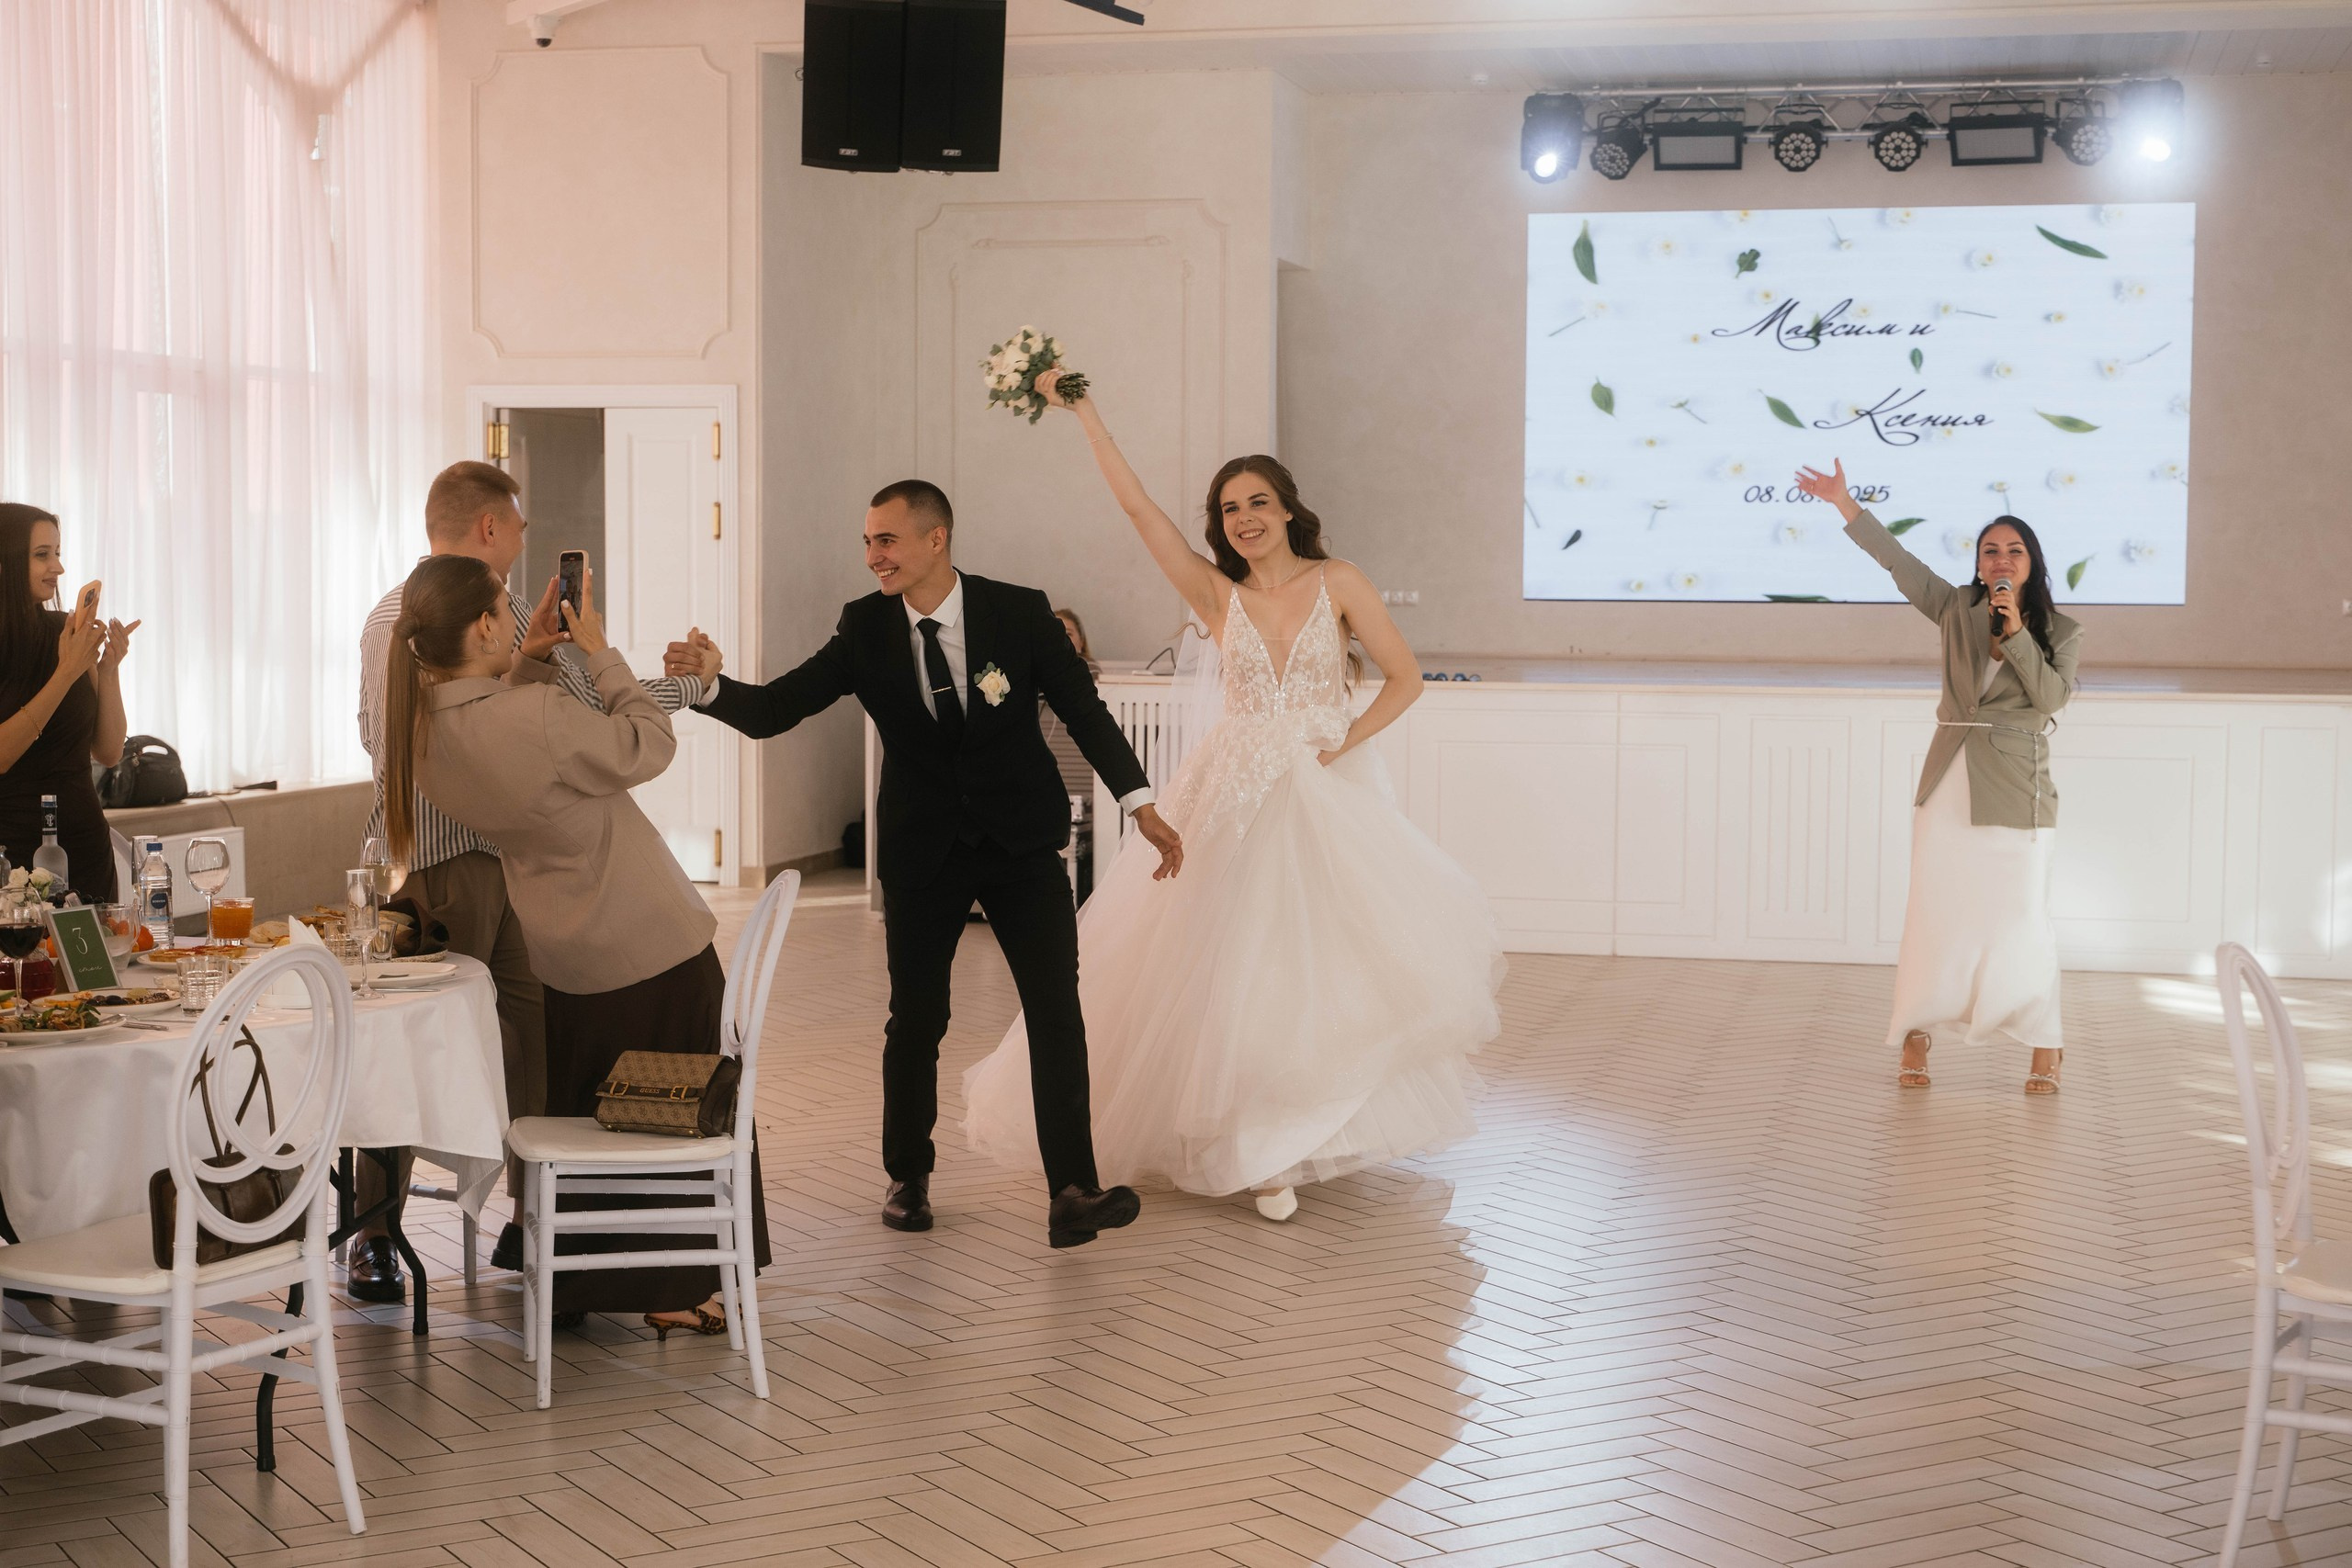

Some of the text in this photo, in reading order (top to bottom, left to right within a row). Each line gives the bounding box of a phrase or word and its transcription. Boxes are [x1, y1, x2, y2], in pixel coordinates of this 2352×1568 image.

[1712, 298, 1934, 351] Максим и
[1813, 388, 1993, 446] Ксения
[73, 927, 87, 954] 3
